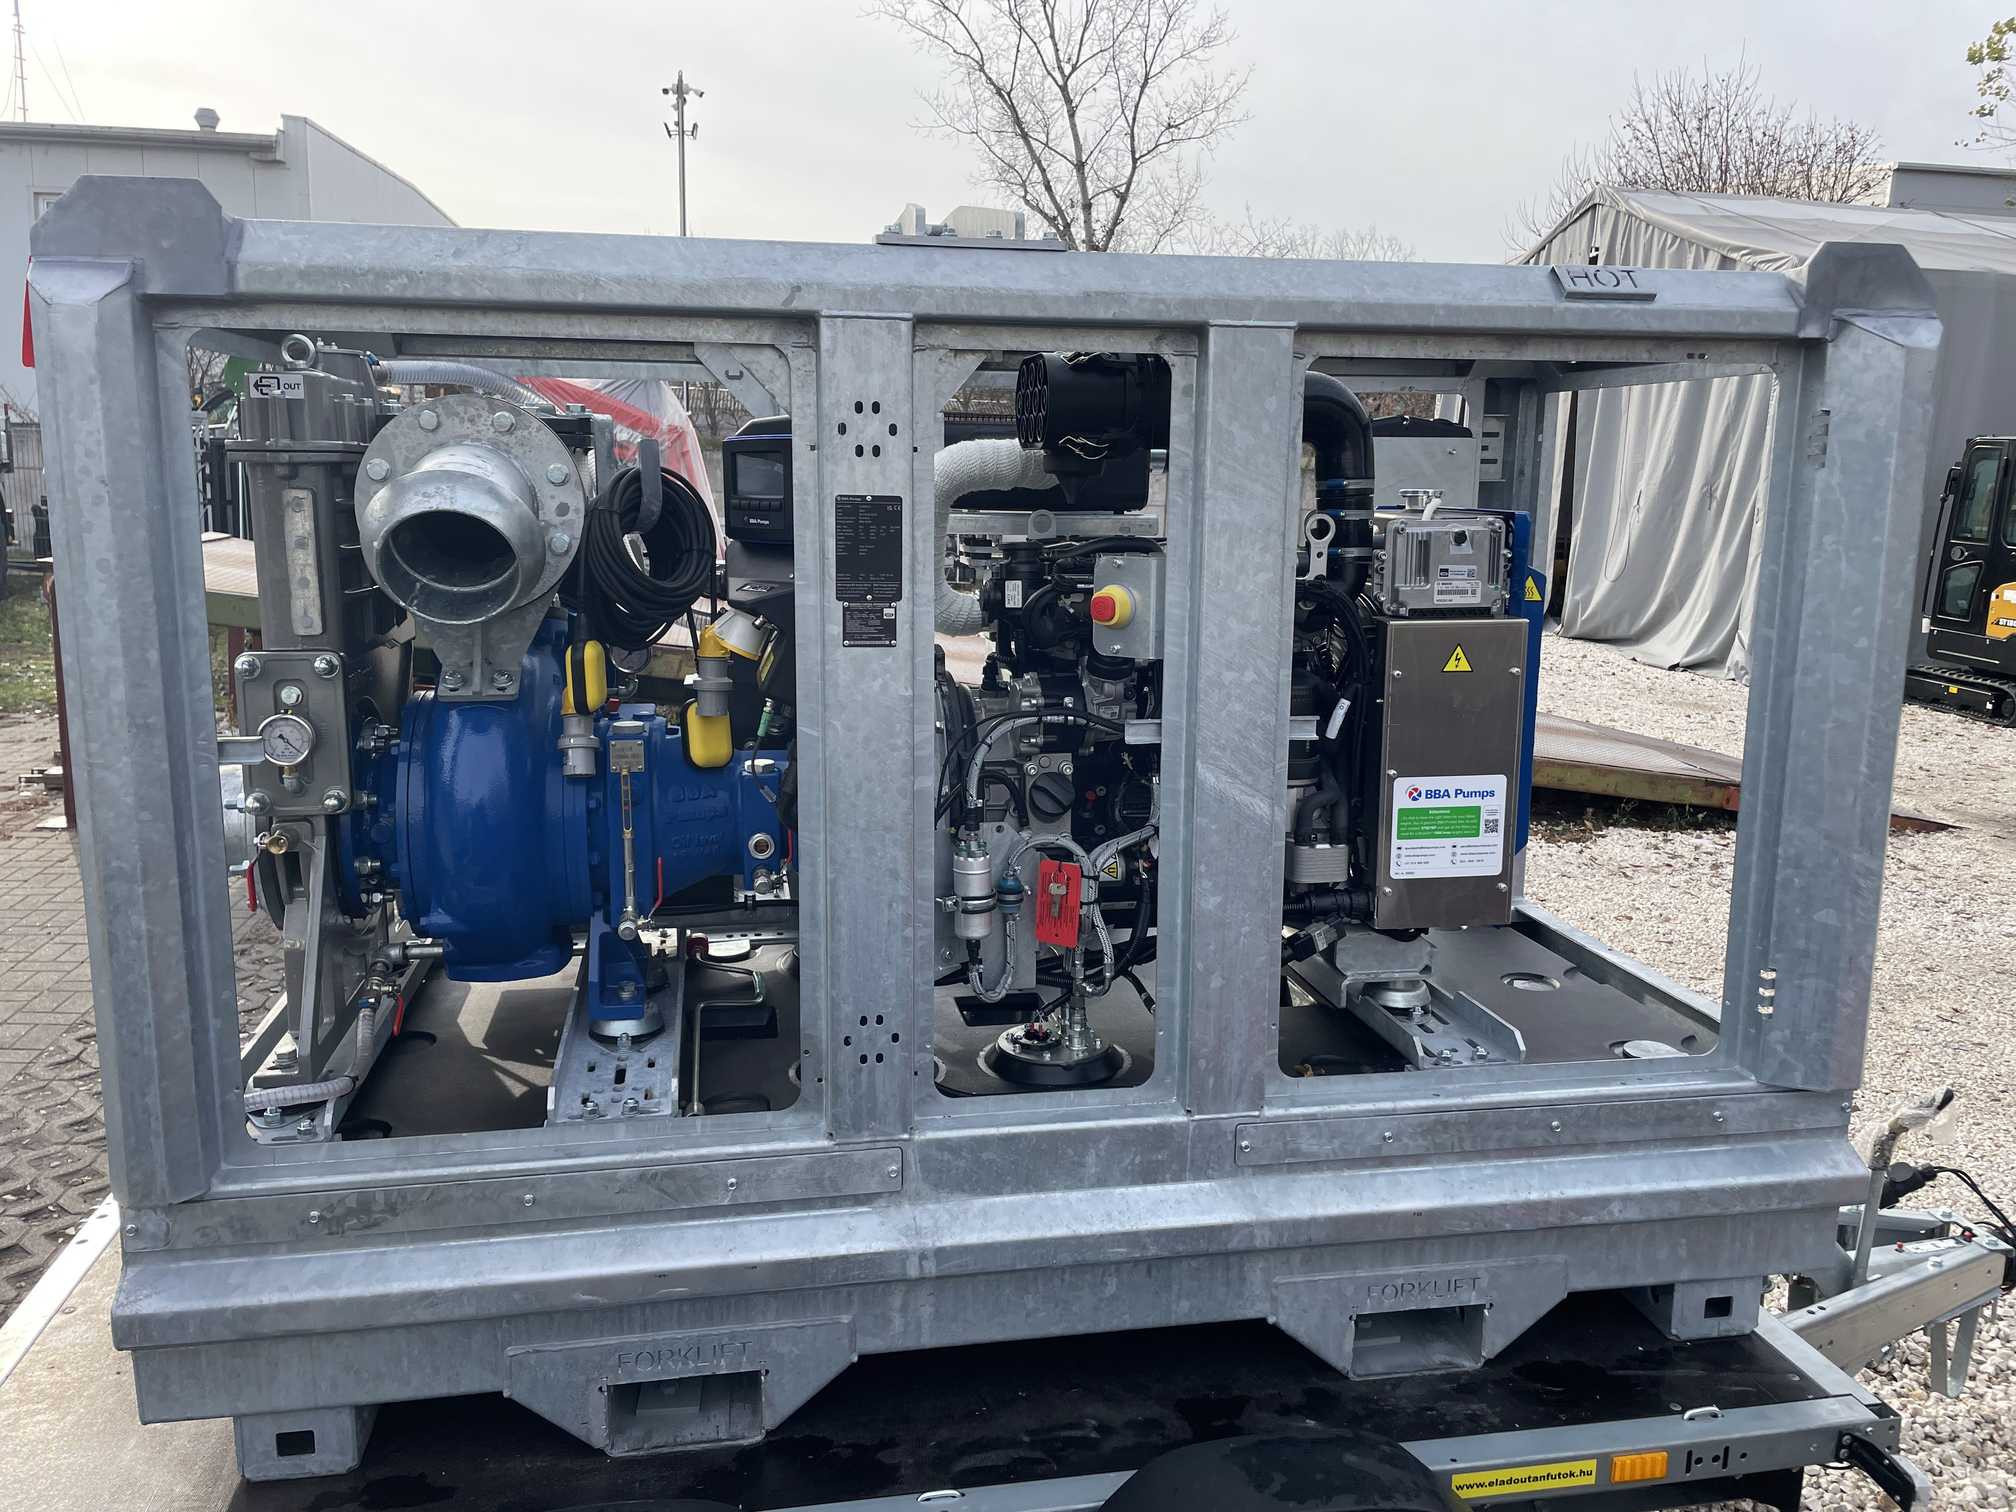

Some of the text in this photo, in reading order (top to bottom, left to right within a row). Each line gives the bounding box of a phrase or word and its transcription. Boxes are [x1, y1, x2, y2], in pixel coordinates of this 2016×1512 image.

[1565, 268, 1638, 289] HOT
[283, 382, 302, 391] OUT
[1424, 788, 1496, 800] BBA Pumps
[1367, 1276, 1481, 1301] FORKLIFT
[617, 1341, 753, 1372] FORKLIFT
[1455, 1468, 1593, 1491] www.eladoutanfutok.hu
